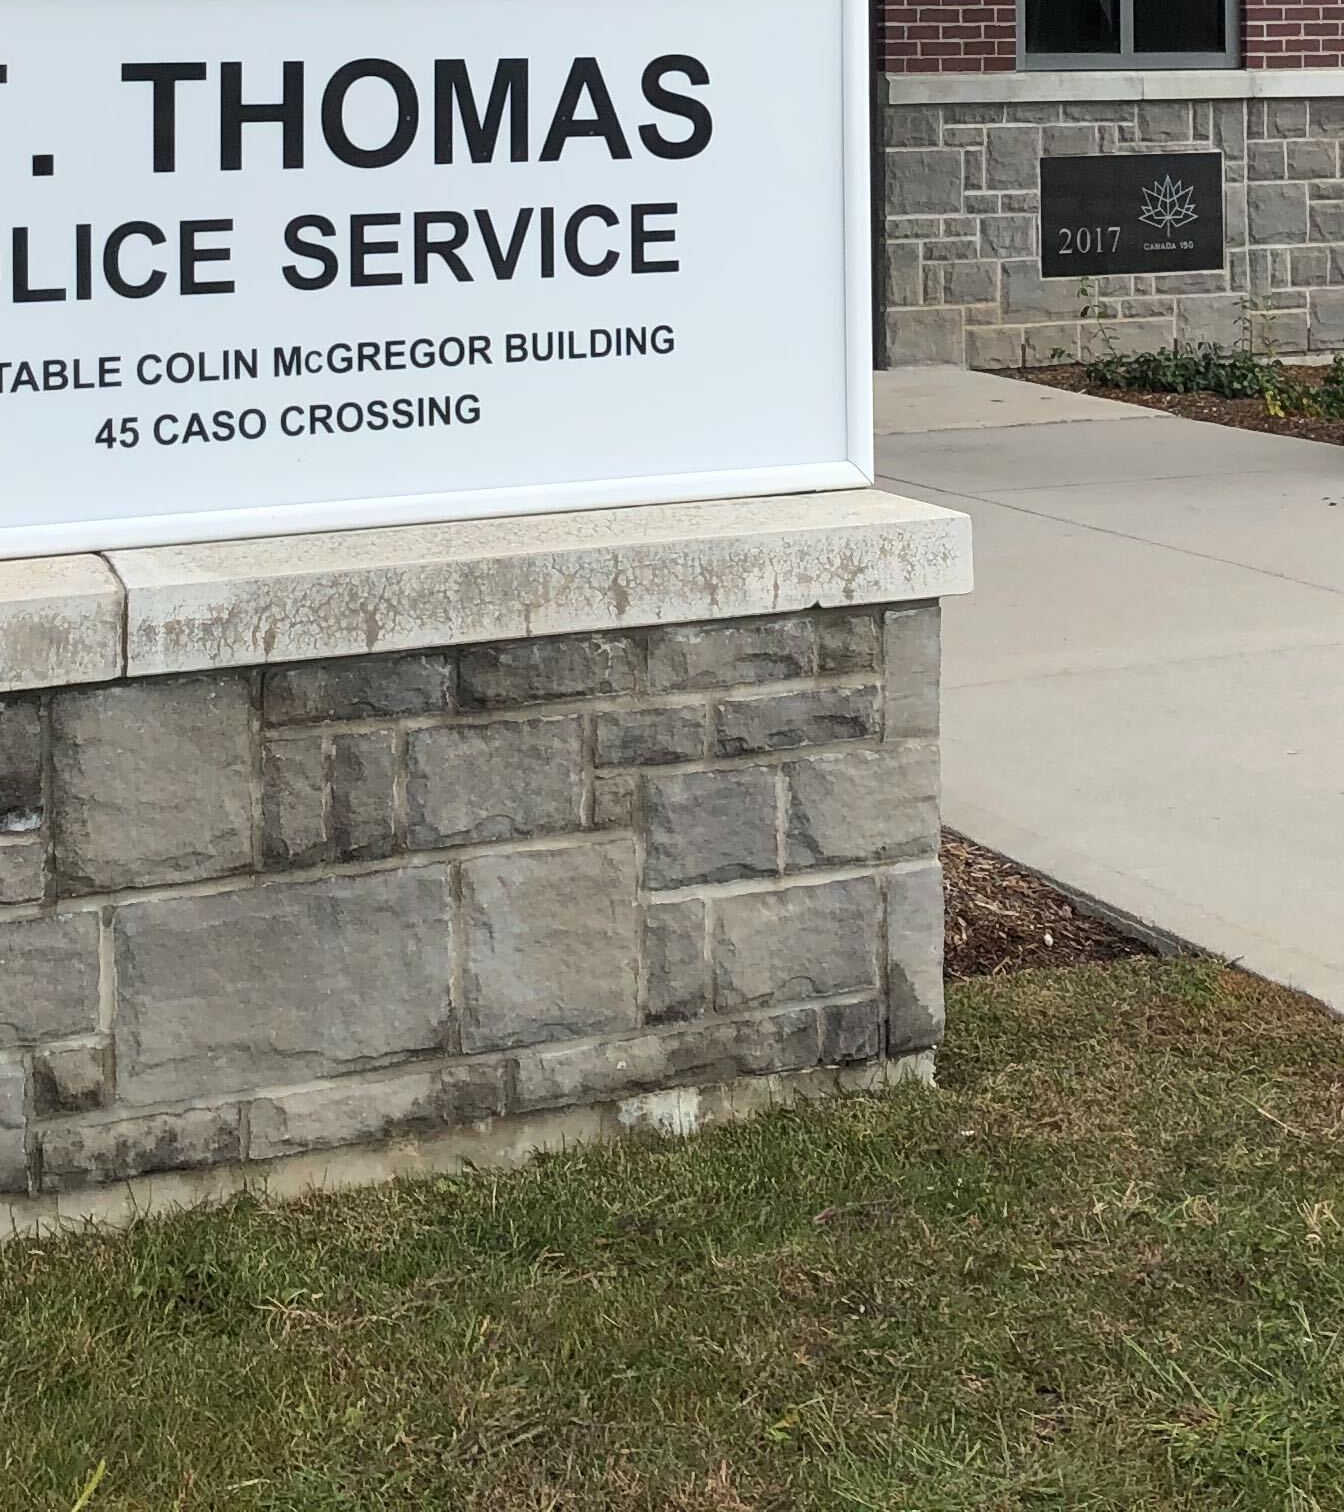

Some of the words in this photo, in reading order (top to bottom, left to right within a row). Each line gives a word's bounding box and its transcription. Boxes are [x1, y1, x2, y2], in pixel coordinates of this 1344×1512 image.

[121, 55, 713, 173] THOMAS
[281, 202, 680, 291] SERVICE
[1058, 226, 1121, 255] 2017
[1143, 242, 1177, 250] CANADA
[1179, 240, 1194, 249] 150
[136, 349, 258, 386] COLIN
[505, 325, 675, 363] BUILDING
[95, 416, 140, 449] 45
[153, 408, 267, 446] CASO
[280, 394, 482, 437] CROSSING
